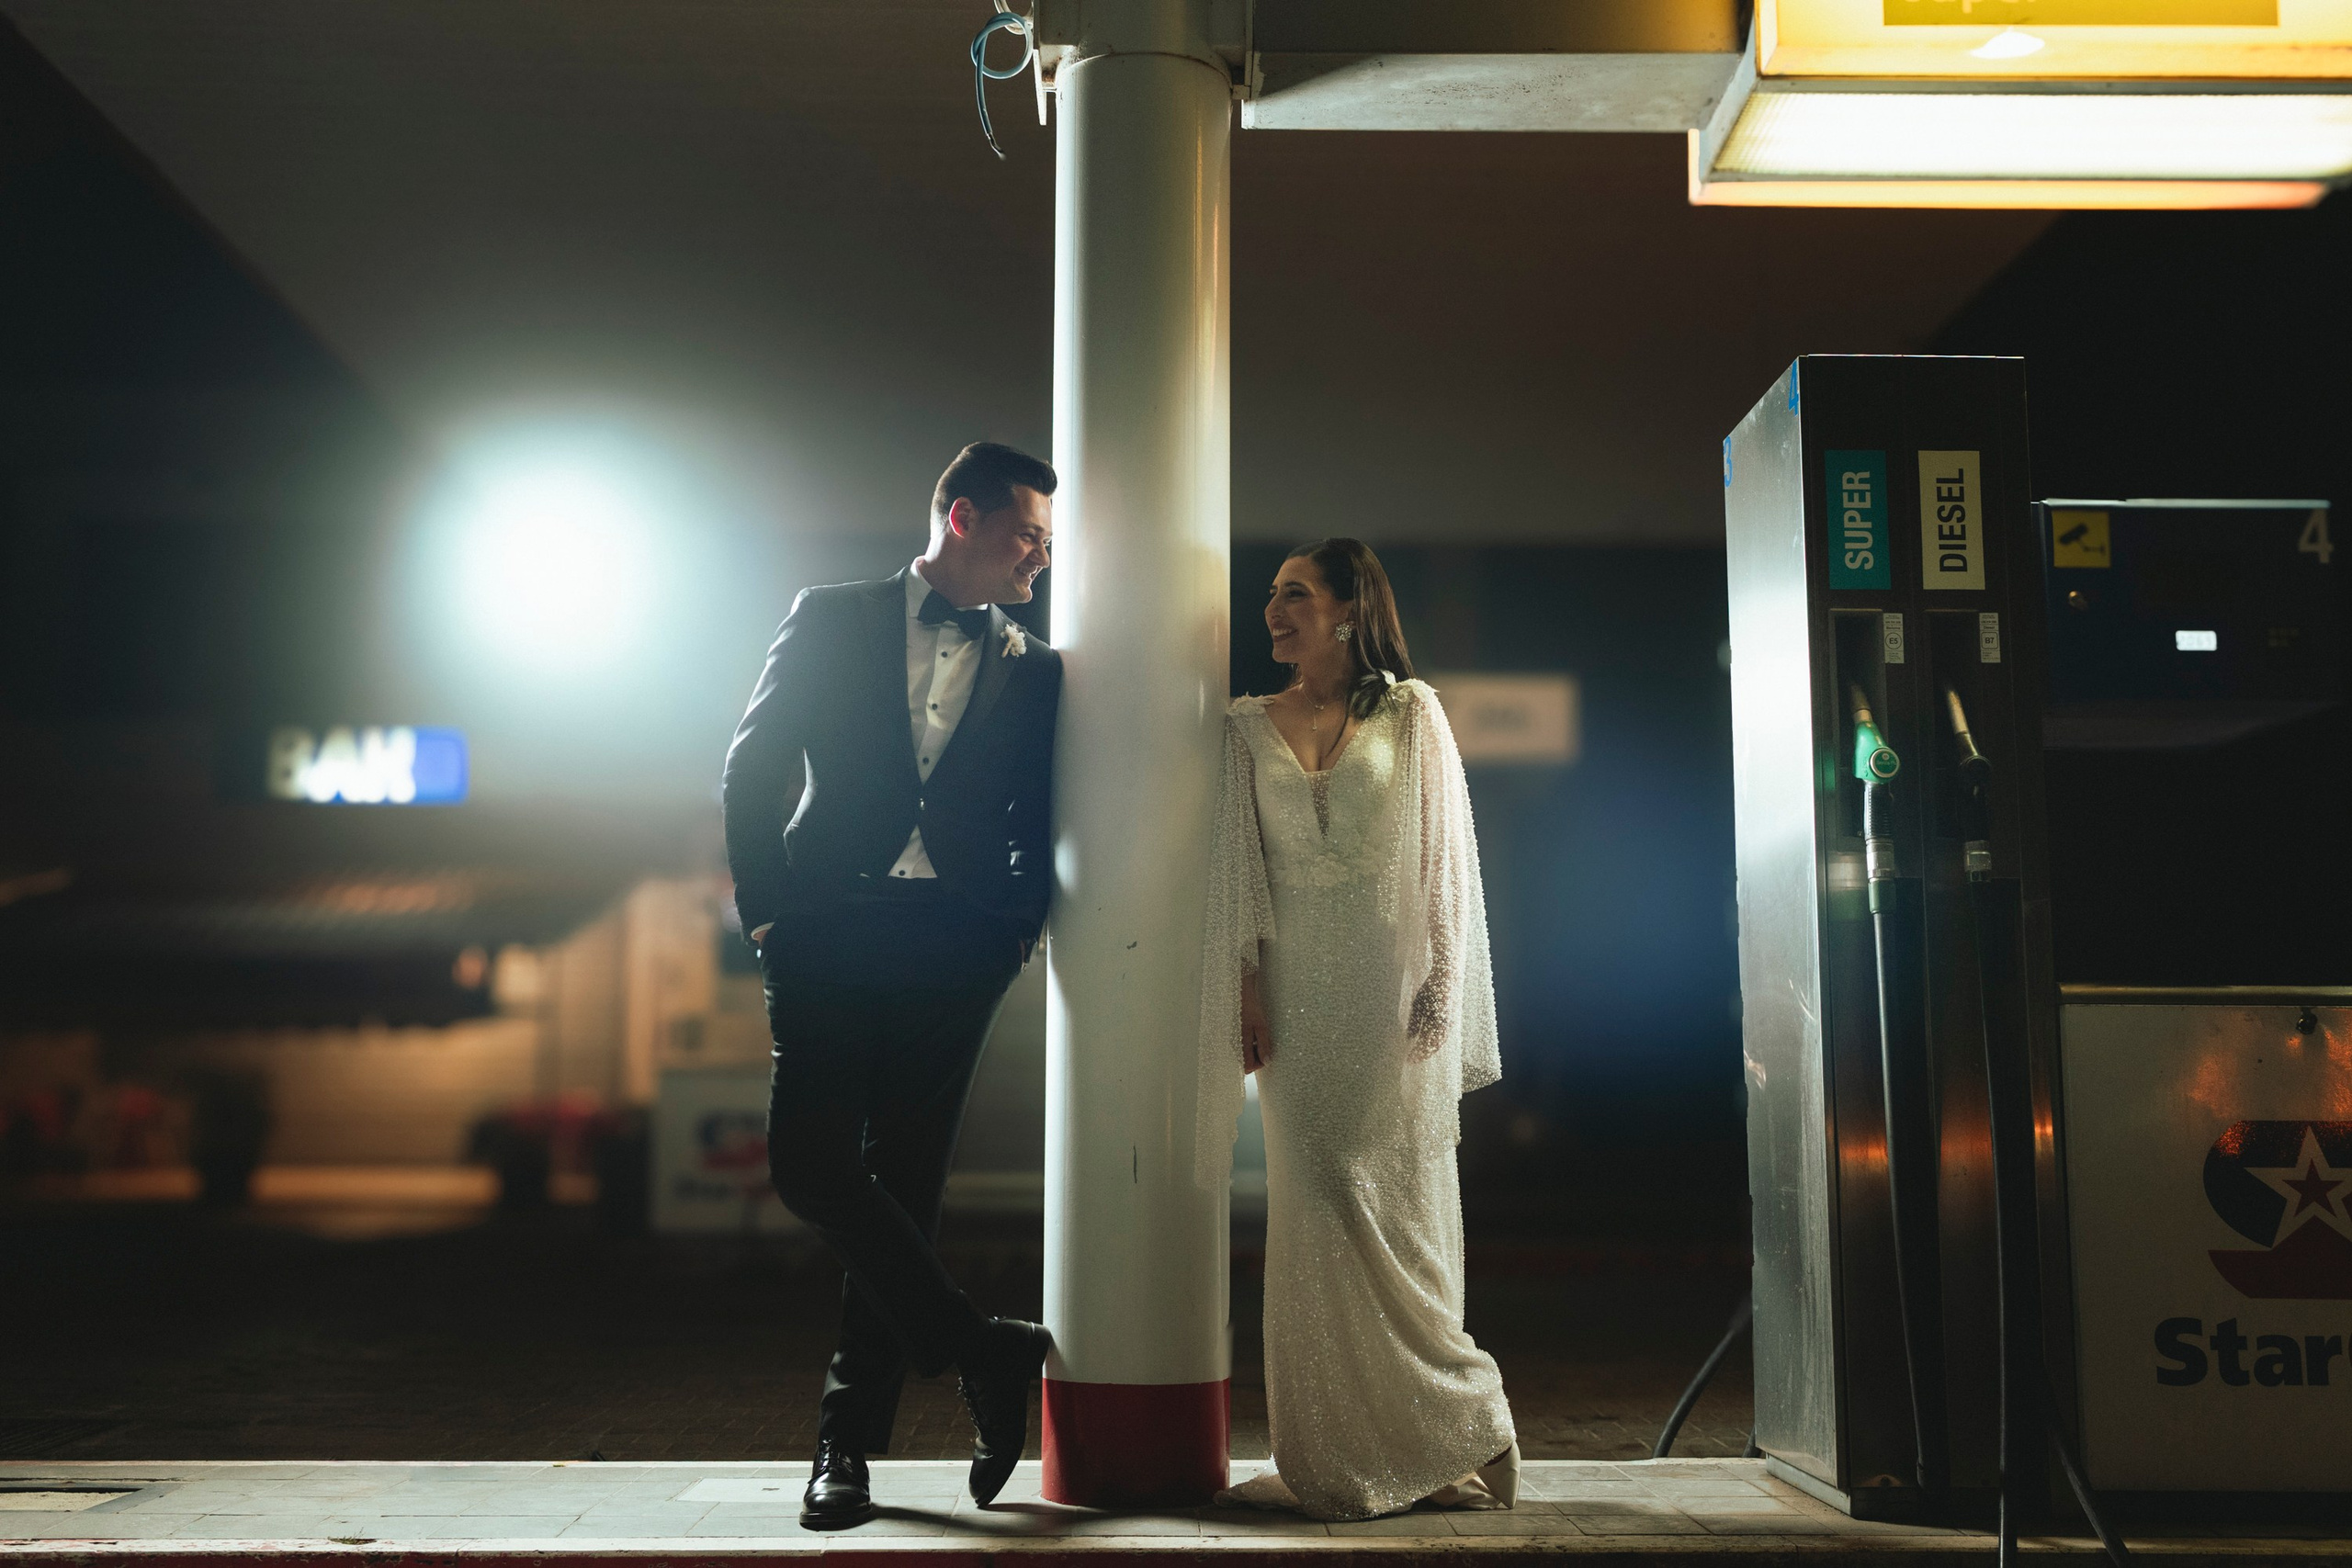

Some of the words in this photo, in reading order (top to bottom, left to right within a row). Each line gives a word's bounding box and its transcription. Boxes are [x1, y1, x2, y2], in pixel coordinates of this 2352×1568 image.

[1842, 470, 1874, 570] SUPER
[1936, 468, 1968, 572] DIESEL
[2298, 507, 2335, 564] 4
[2154, 1316, 2352, 1387] Star
